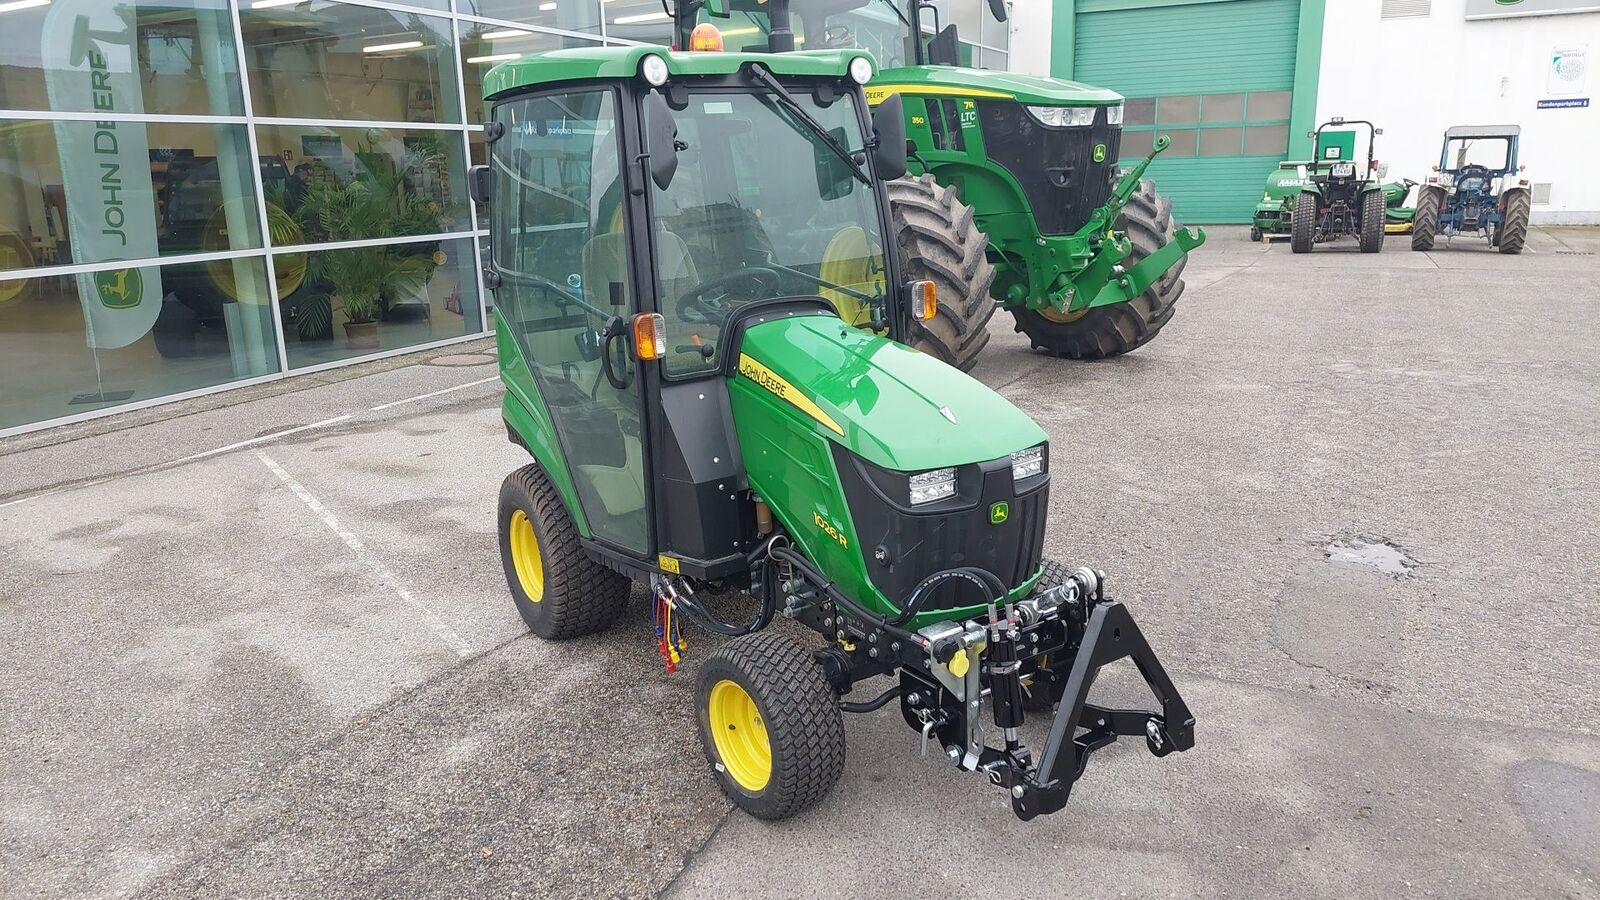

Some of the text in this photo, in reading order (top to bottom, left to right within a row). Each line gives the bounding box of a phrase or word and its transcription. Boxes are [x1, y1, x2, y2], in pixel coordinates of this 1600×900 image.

[866, 91, 884, 99] DEERE
[963, 101, 974, 109] 7R
[961, 111, 975, 122] LTC
[100, 162, 127, 246] JOHN
[742, 362, 786, 396] JOHN DEERE
